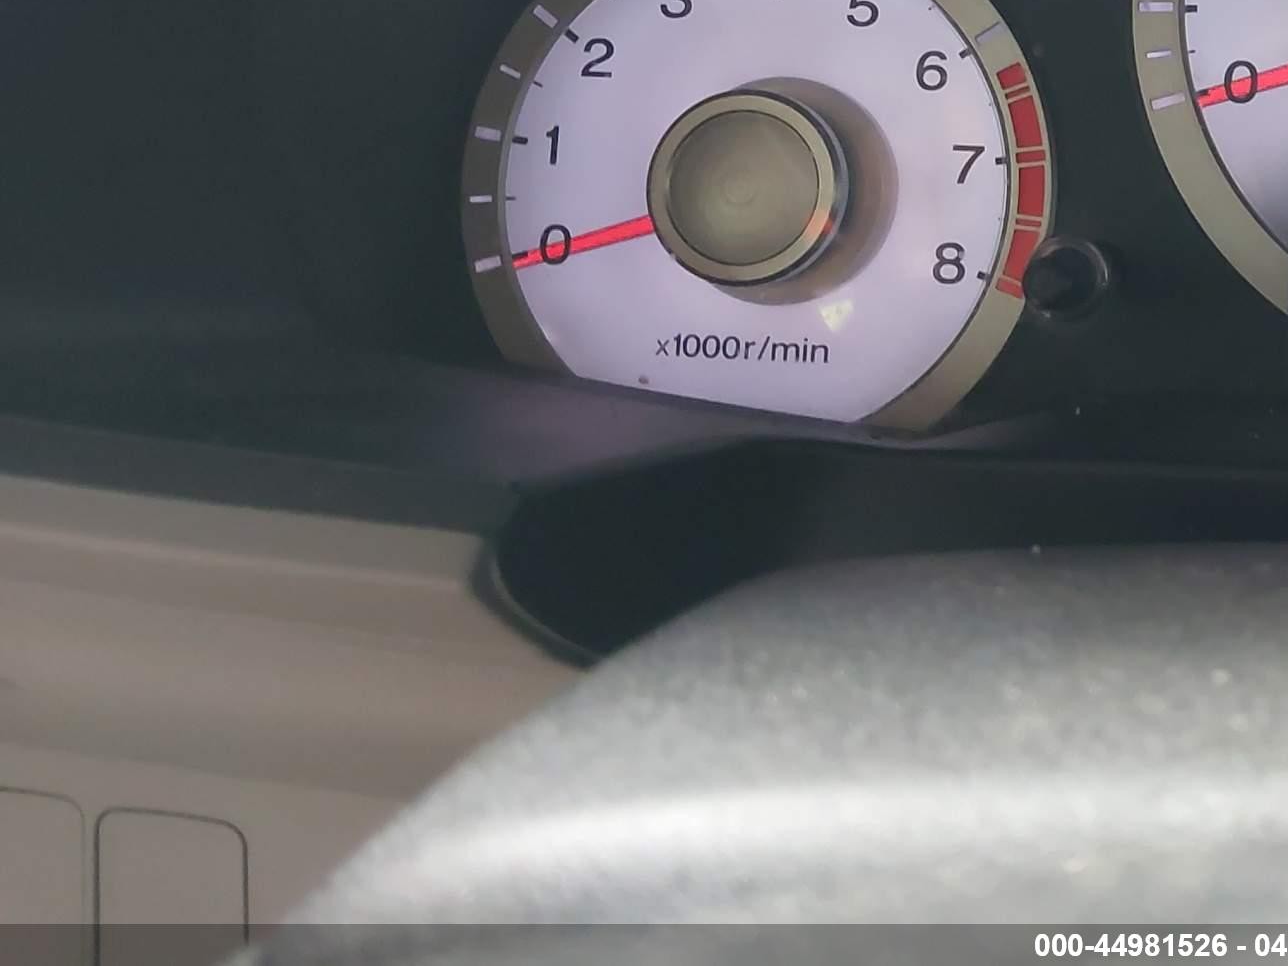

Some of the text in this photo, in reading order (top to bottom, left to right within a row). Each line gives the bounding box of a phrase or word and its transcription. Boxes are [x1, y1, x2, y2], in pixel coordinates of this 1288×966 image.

[580, 39, 616, 79] 2
[915, 51, 949, 91] 6
[1223, 60, 1258, 103] 0
[545, 126, 560, 165] 1
[952, 145, 985, 185] 7
[539, 223, 573, 265] 0
[932, 243, 967, 284] 8
